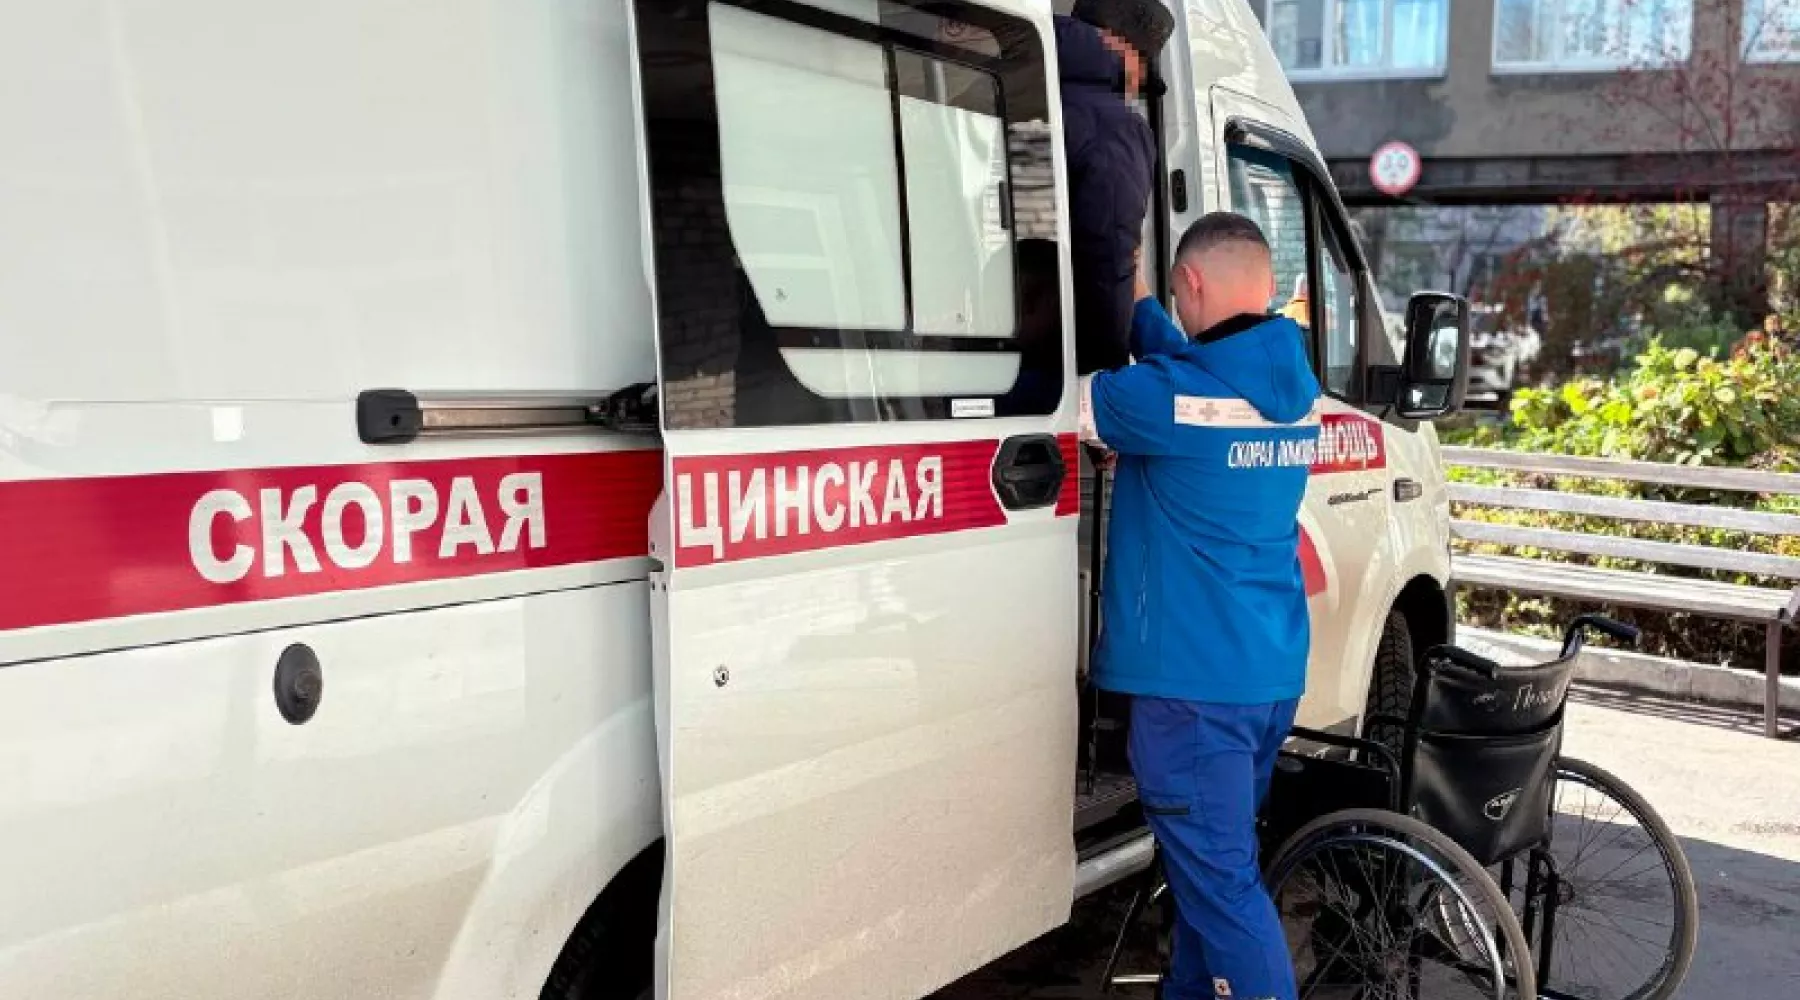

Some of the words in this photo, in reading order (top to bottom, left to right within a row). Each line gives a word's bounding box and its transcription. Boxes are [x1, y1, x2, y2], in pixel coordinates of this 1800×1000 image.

[1228, 441, 1275, 467] СКОРАЯ
[1278, 439, 1316, 466] ПОМО
[188, 472, 547, 583] СКОРАЯ
[677, 456, 944, 559] ЦИНСКАЯ
